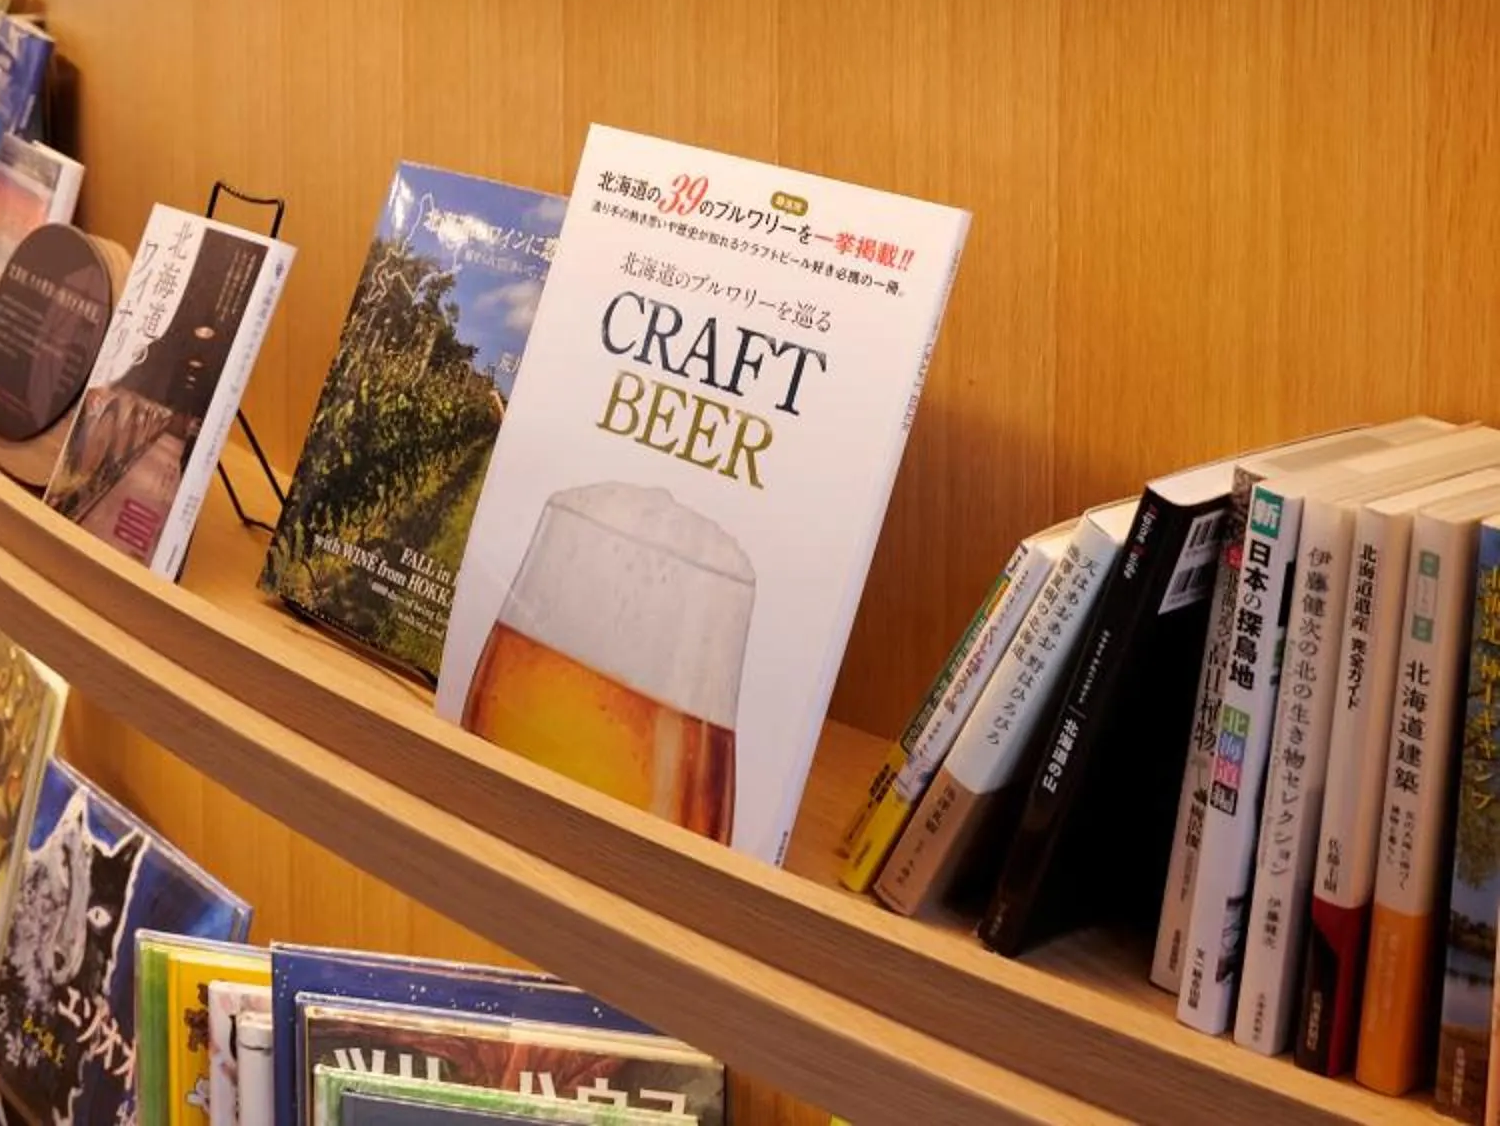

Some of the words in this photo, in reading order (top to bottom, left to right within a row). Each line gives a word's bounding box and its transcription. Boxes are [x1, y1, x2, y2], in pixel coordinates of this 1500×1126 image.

[619, 251, 832, 334] 北海道のブルワリーを巡る
[601, 290, 828, 416] CRAFT
[596, 370, 774, 490] BEER
[314, 533, 341, 555] with
[343, 543, 379, 573] WINE
[377, 558, 407, 587] from
[407, 572, 453, 609] HOKK
[1394, 659, 1431, 795] 北海道建築
